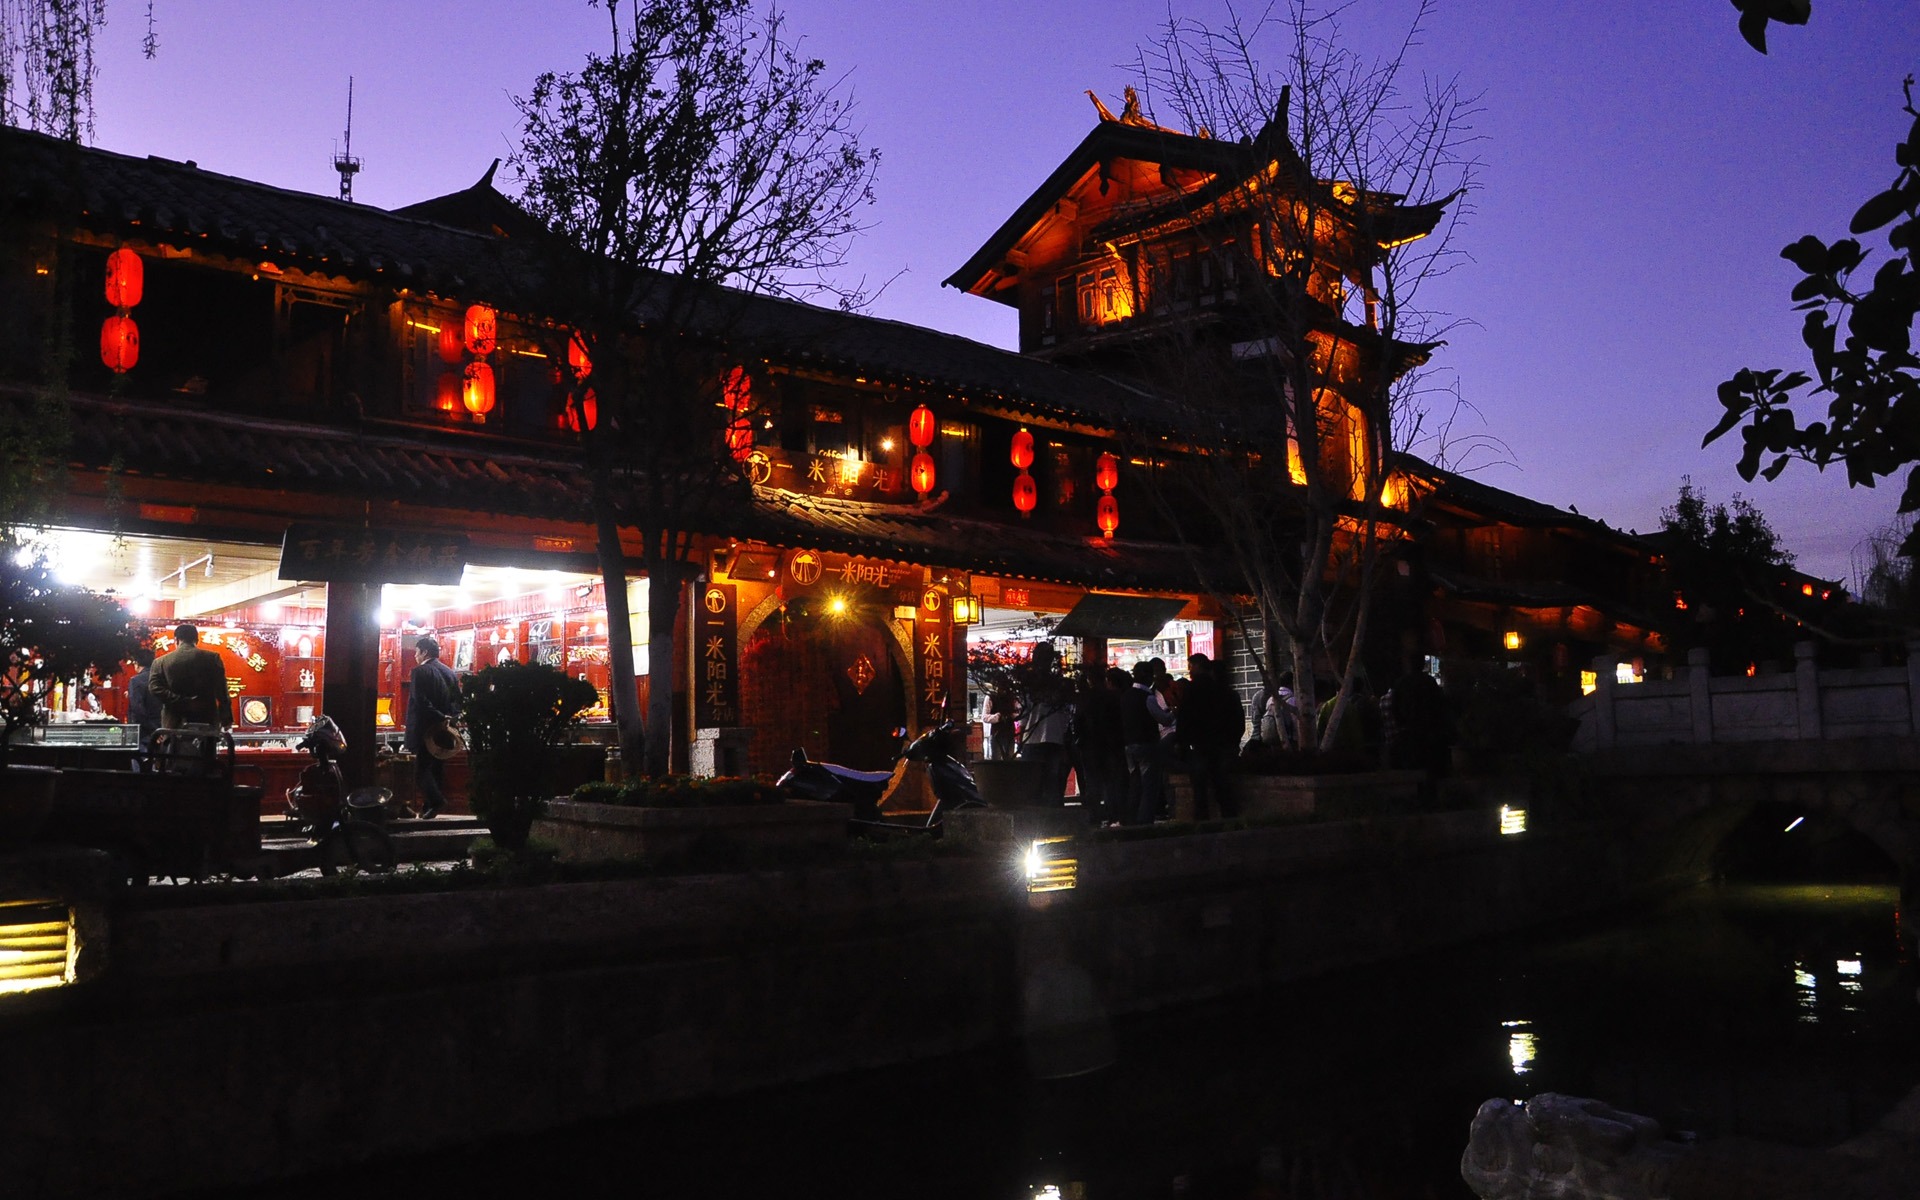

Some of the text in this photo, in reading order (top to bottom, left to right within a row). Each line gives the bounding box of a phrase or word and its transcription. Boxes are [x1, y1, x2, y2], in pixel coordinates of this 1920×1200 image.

[776, 458, 890, 491] 一米阳光
[825, 561, 890, 588] 一米阳光
[705, 620, 727, 706] 一米阳光
[923, 617, 943, 704] 一米阳光
